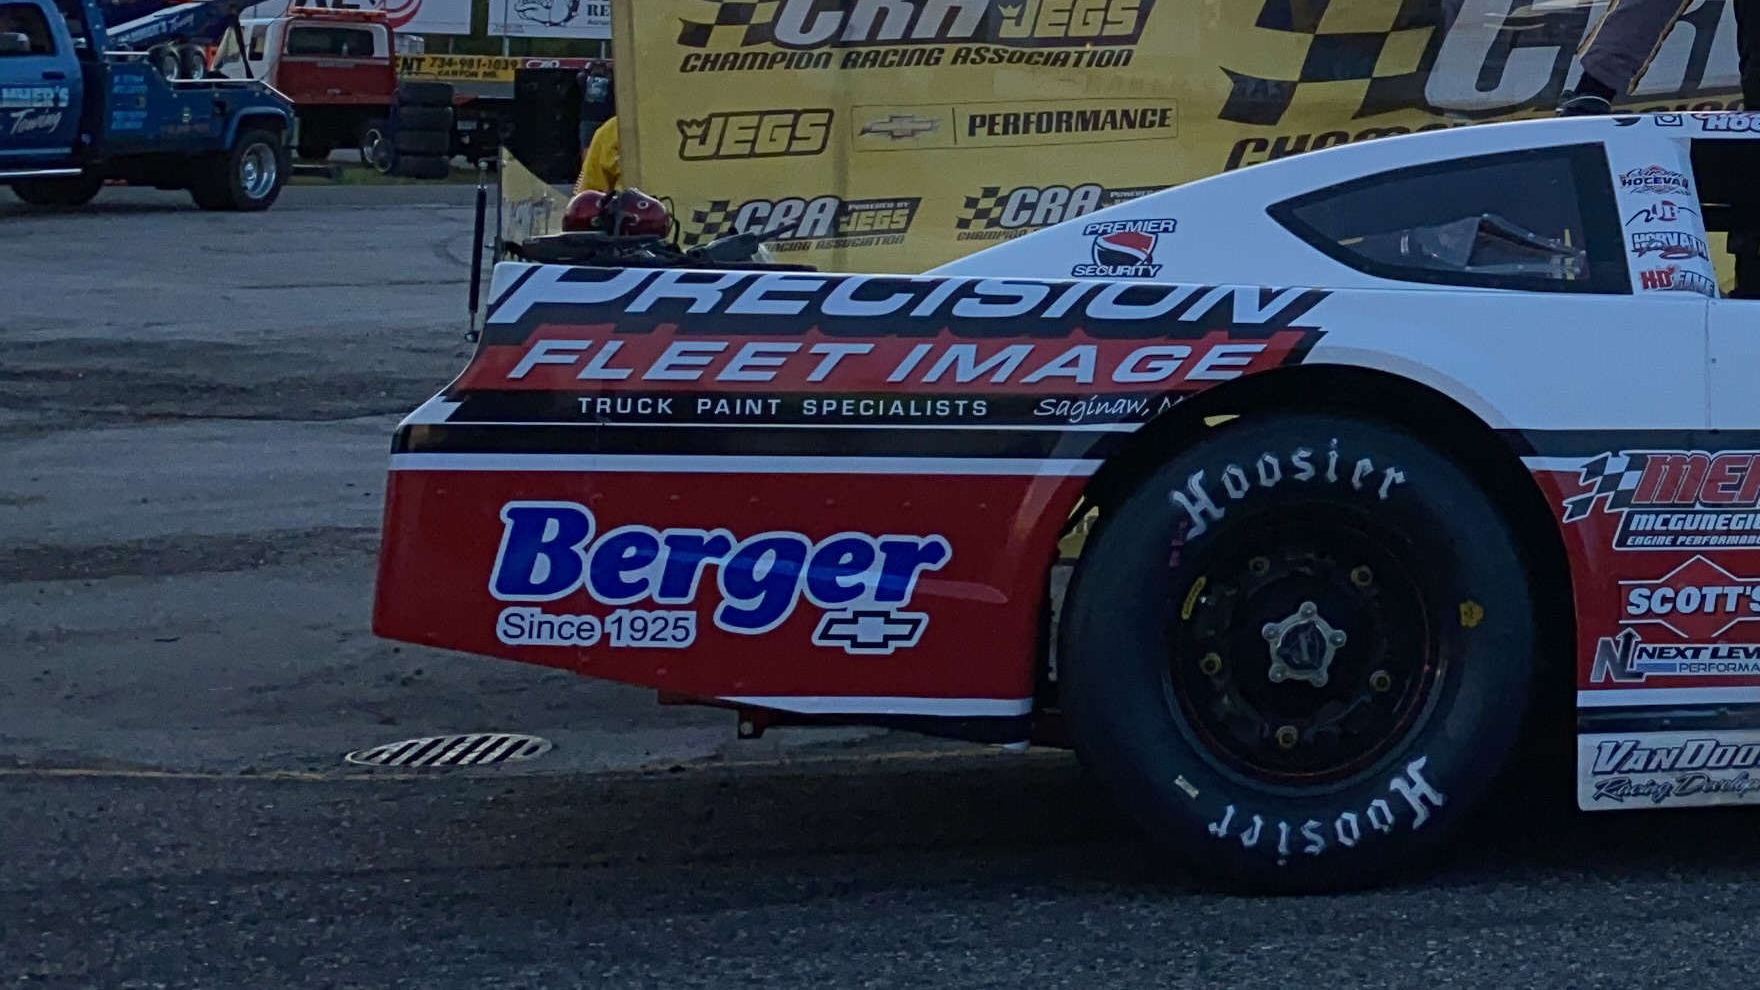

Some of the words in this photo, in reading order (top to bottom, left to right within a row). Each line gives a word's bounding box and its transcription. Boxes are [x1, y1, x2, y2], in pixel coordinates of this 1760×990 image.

[679, 49, 832, 73] CHAMPION
[841, 47, 942, 71] RACING
[950, 46, 1134, 69] ASSOCIATION
[10, 108, 62, 135] Towing
[676, 108, 834, 161] JEGS
[968, 106, 1172, 137] PERFORMANCE
[735, 197, 840, 239] CRA
[841, 209, 909, 232] JEGS
[999, 185, 1101, 228] CRA
[1085, 220, 1176, 235] PREMIER
[1632, 231, 1709, 261] HORVATH
[1073, 264, 1162, 277] SECURITY
[487, 264, 1309, 324] PRECISION
[507, 339, 875, 382] FLEET
[886, 342, 1268, 383] IMAGE
[578, 398, 673, 415] TRUCK
[698, 398, 782, 415] PAINT
[803, 399, 989, 416] SPECIALISTS
[1033, 395, 1150, 423] Saginaw,
[1169, 438, 1406, 541] Hoosier
[1626, 535, 1674, 546] ENGINE
[494, 505, 947, 631] Berger
[503, 612, 596, 642] Since
[609, 613, 691, 643] 1925
[1637, 646, 1708, 660] NEXT
[1594, 777, 1674, 802] Racing
[1207, 755, 1448, 866] Hoosier
